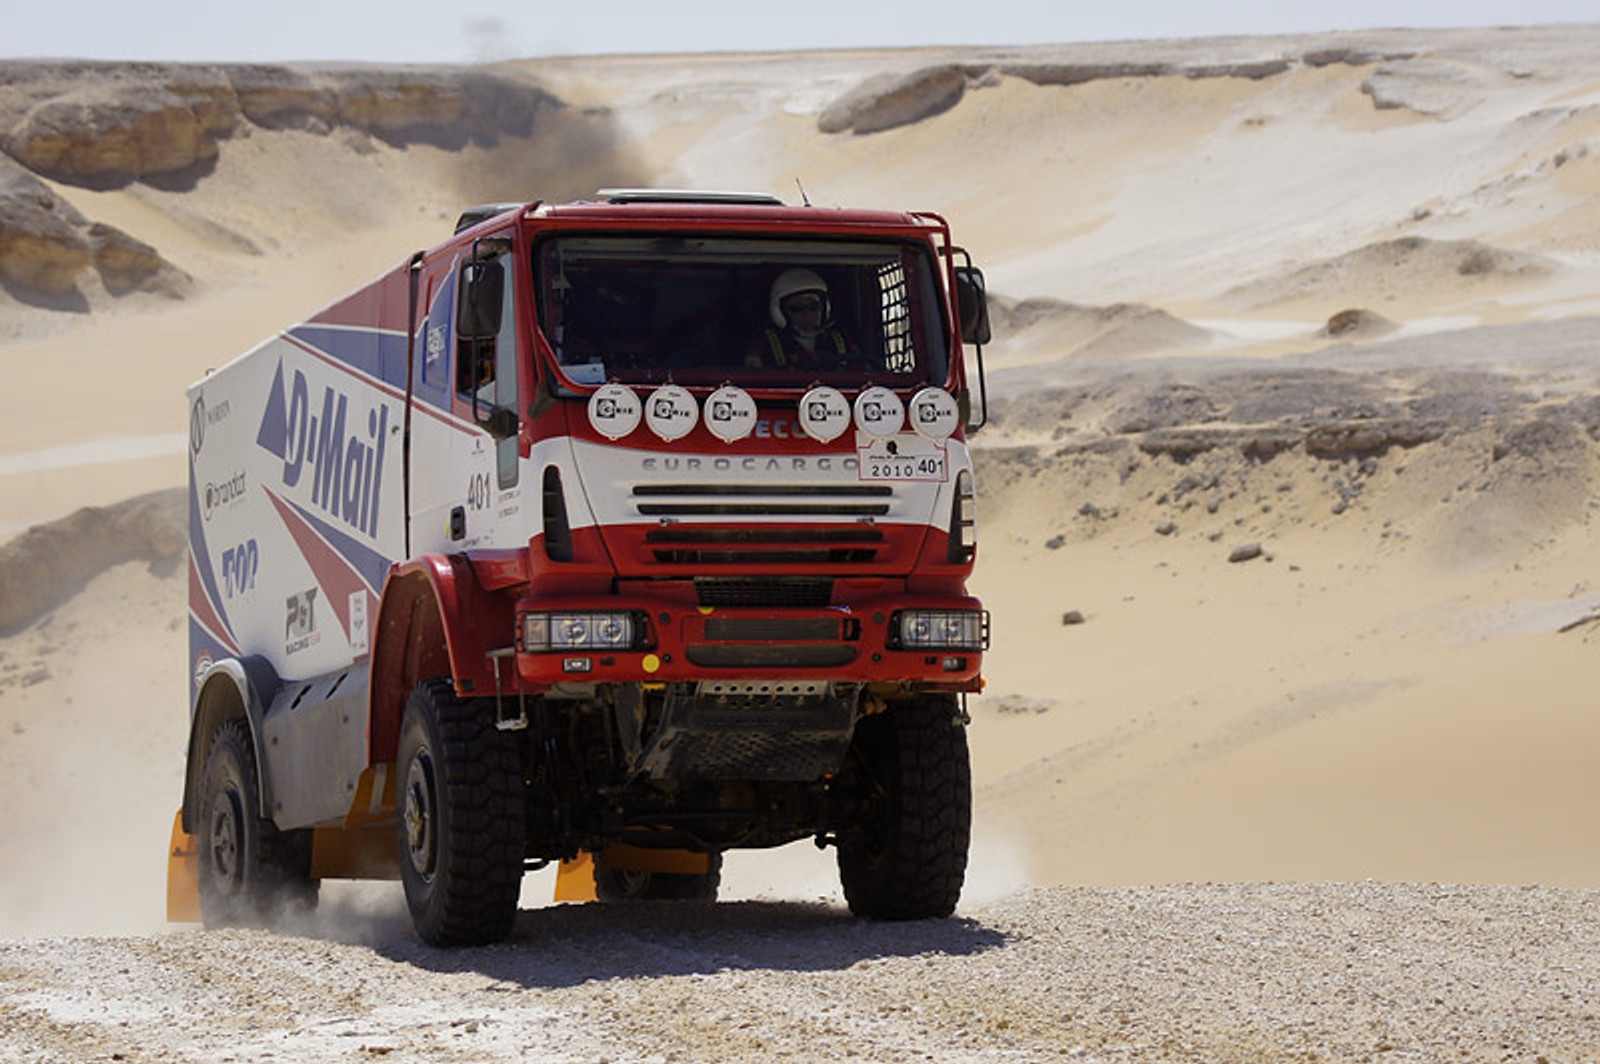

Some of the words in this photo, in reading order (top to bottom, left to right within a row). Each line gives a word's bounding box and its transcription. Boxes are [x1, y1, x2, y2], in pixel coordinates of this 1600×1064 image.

[282, 369, 389, 540] D-Mail
[642, 458, 858, 471] EUROCARGO
[871, 465, 913, 477] 2010
[918, 459, 944, 475] 401
[468, 471, 492, 510] 401
